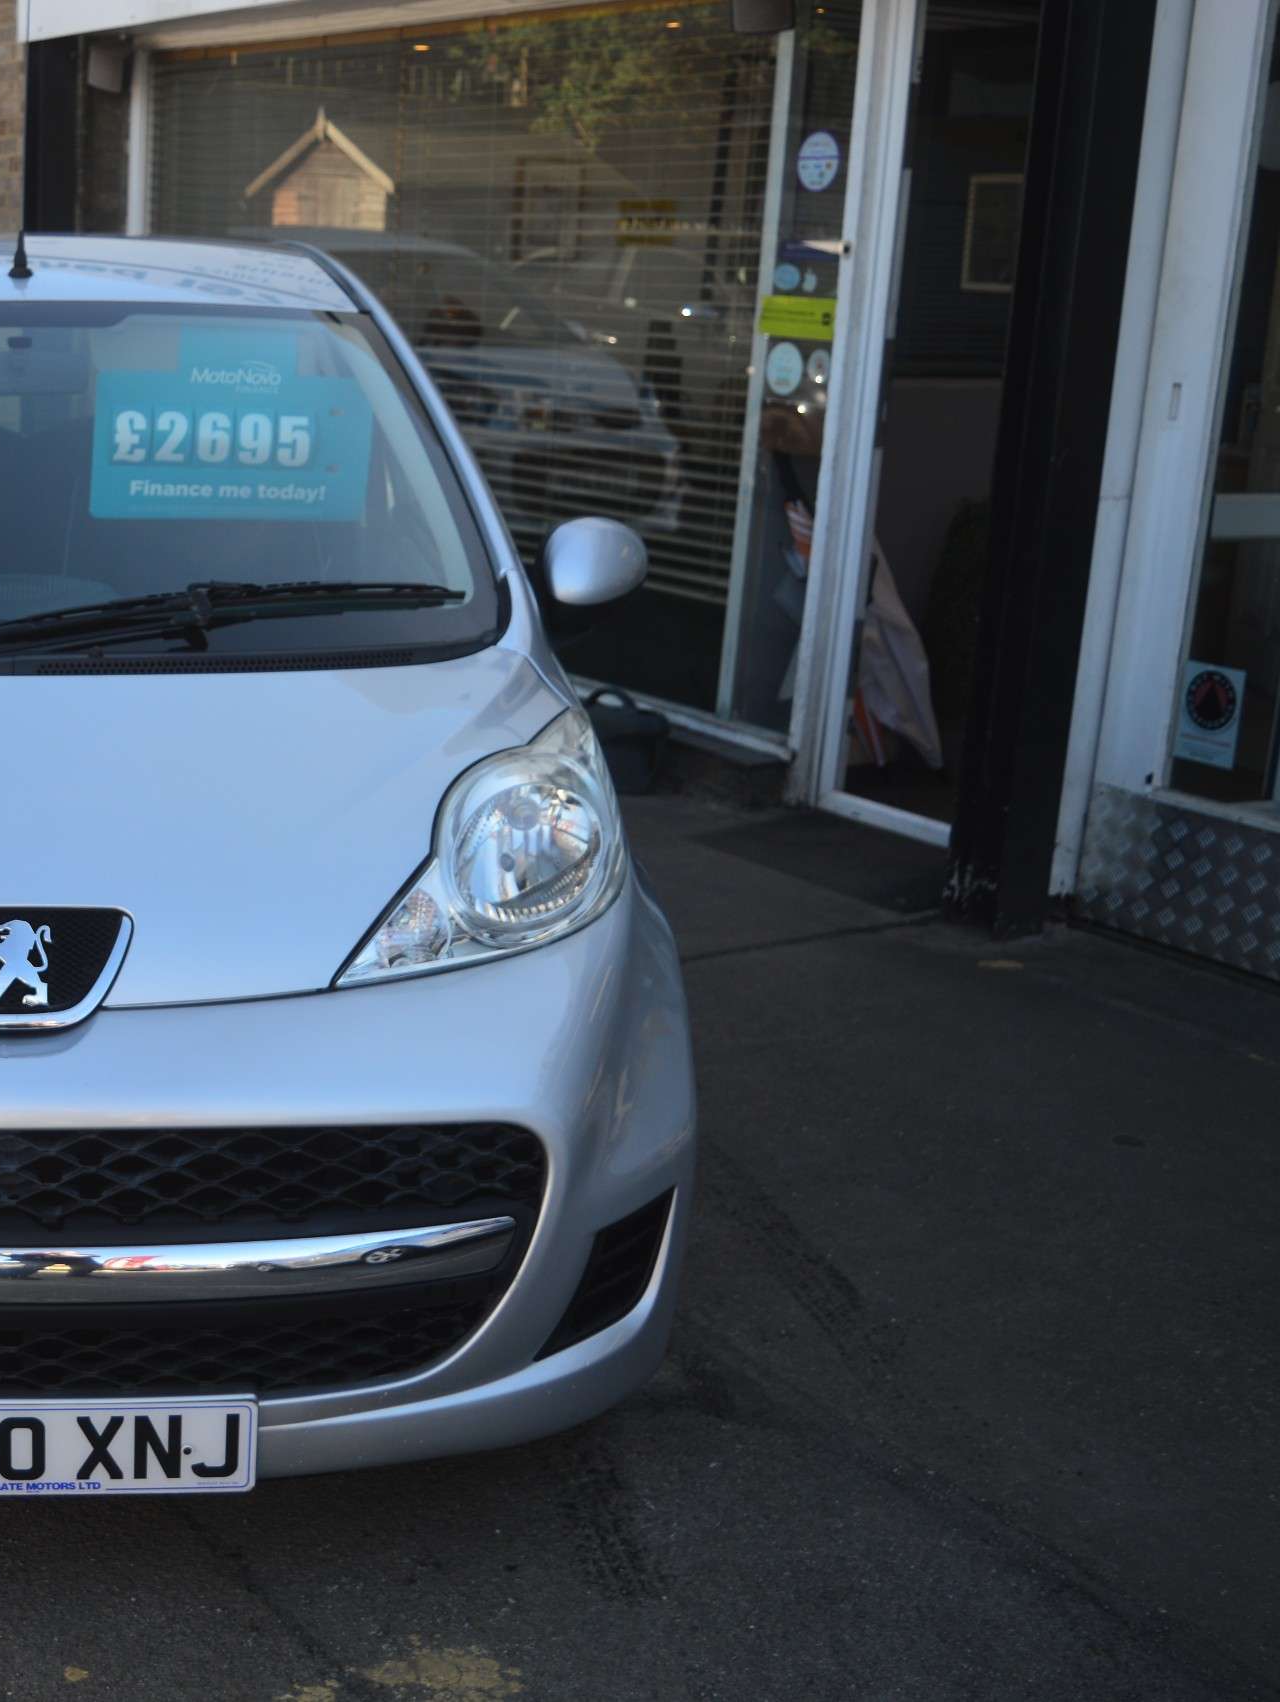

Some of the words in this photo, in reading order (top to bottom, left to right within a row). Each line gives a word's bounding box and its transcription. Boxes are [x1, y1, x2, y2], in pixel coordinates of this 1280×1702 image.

[190, 366, 283, 385] MotoNovo
[113, 410, 311, 467] £2695
[129, 480, 212, 497] Finance
[219, 483, 252, 498] me
[258, 484, 326, 503] today!
[75, 1413, 241, 1480] XNJ
[26, 1482, 75, 1491] MOTORS
[79, 1481, 101, 1490] LTD
